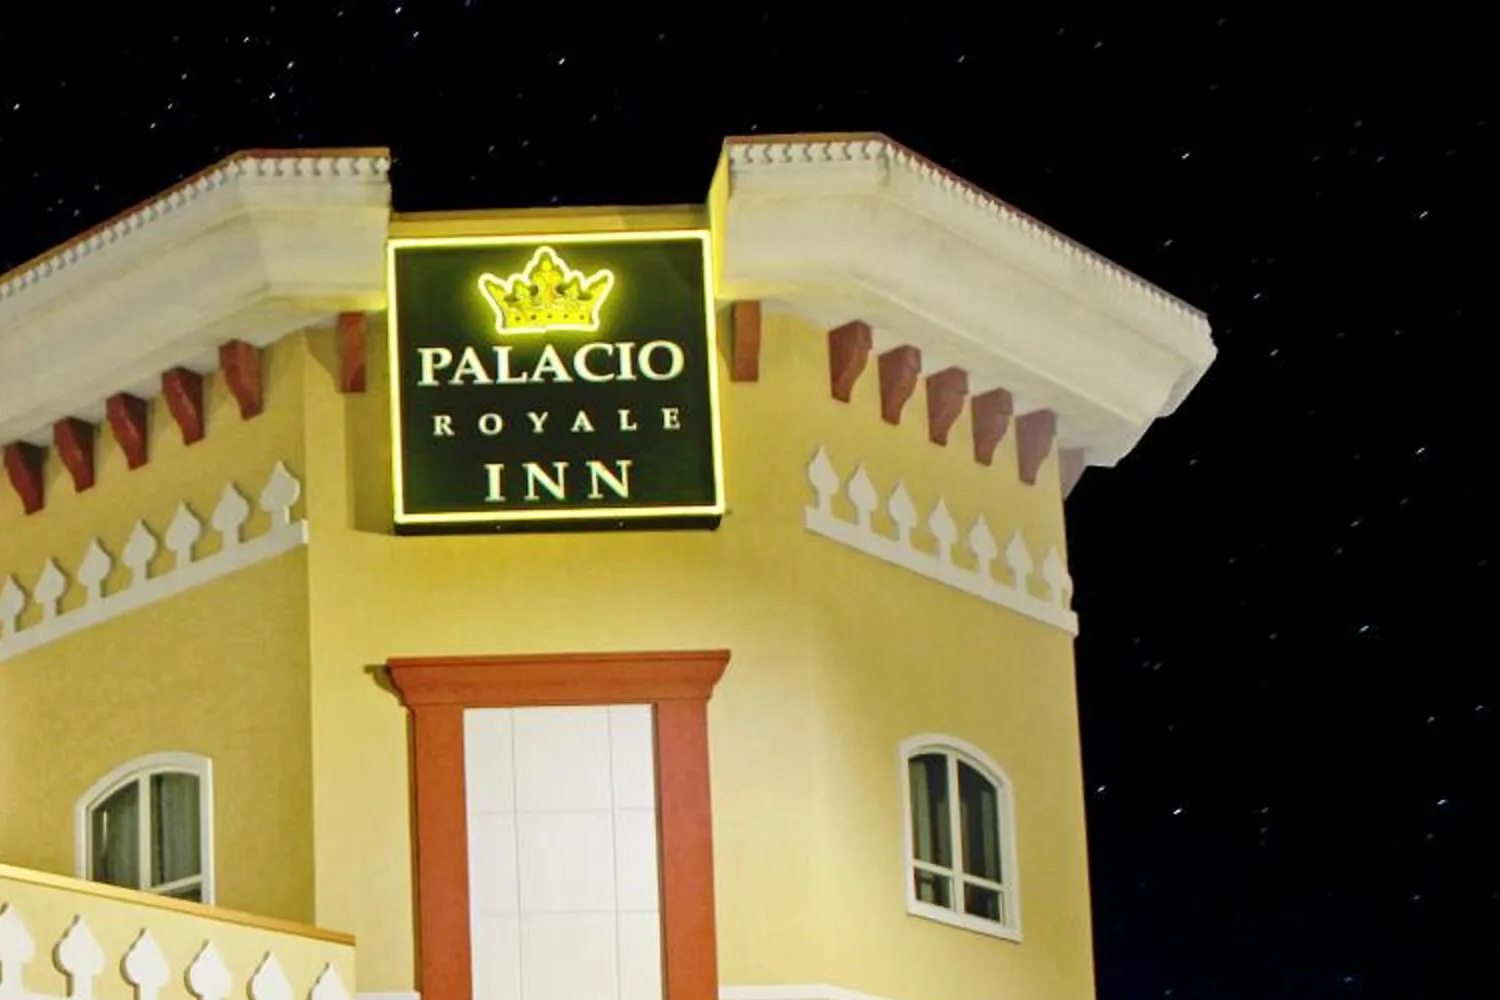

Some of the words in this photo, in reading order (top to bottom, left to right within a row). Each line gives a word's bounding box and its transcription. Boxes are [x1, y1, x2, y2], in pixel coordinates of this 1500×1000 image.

[417, 340, 685, 387] PALACIO
[432, 407, 682, 437] ROYALE
[484, 459, 634, 502] INN
